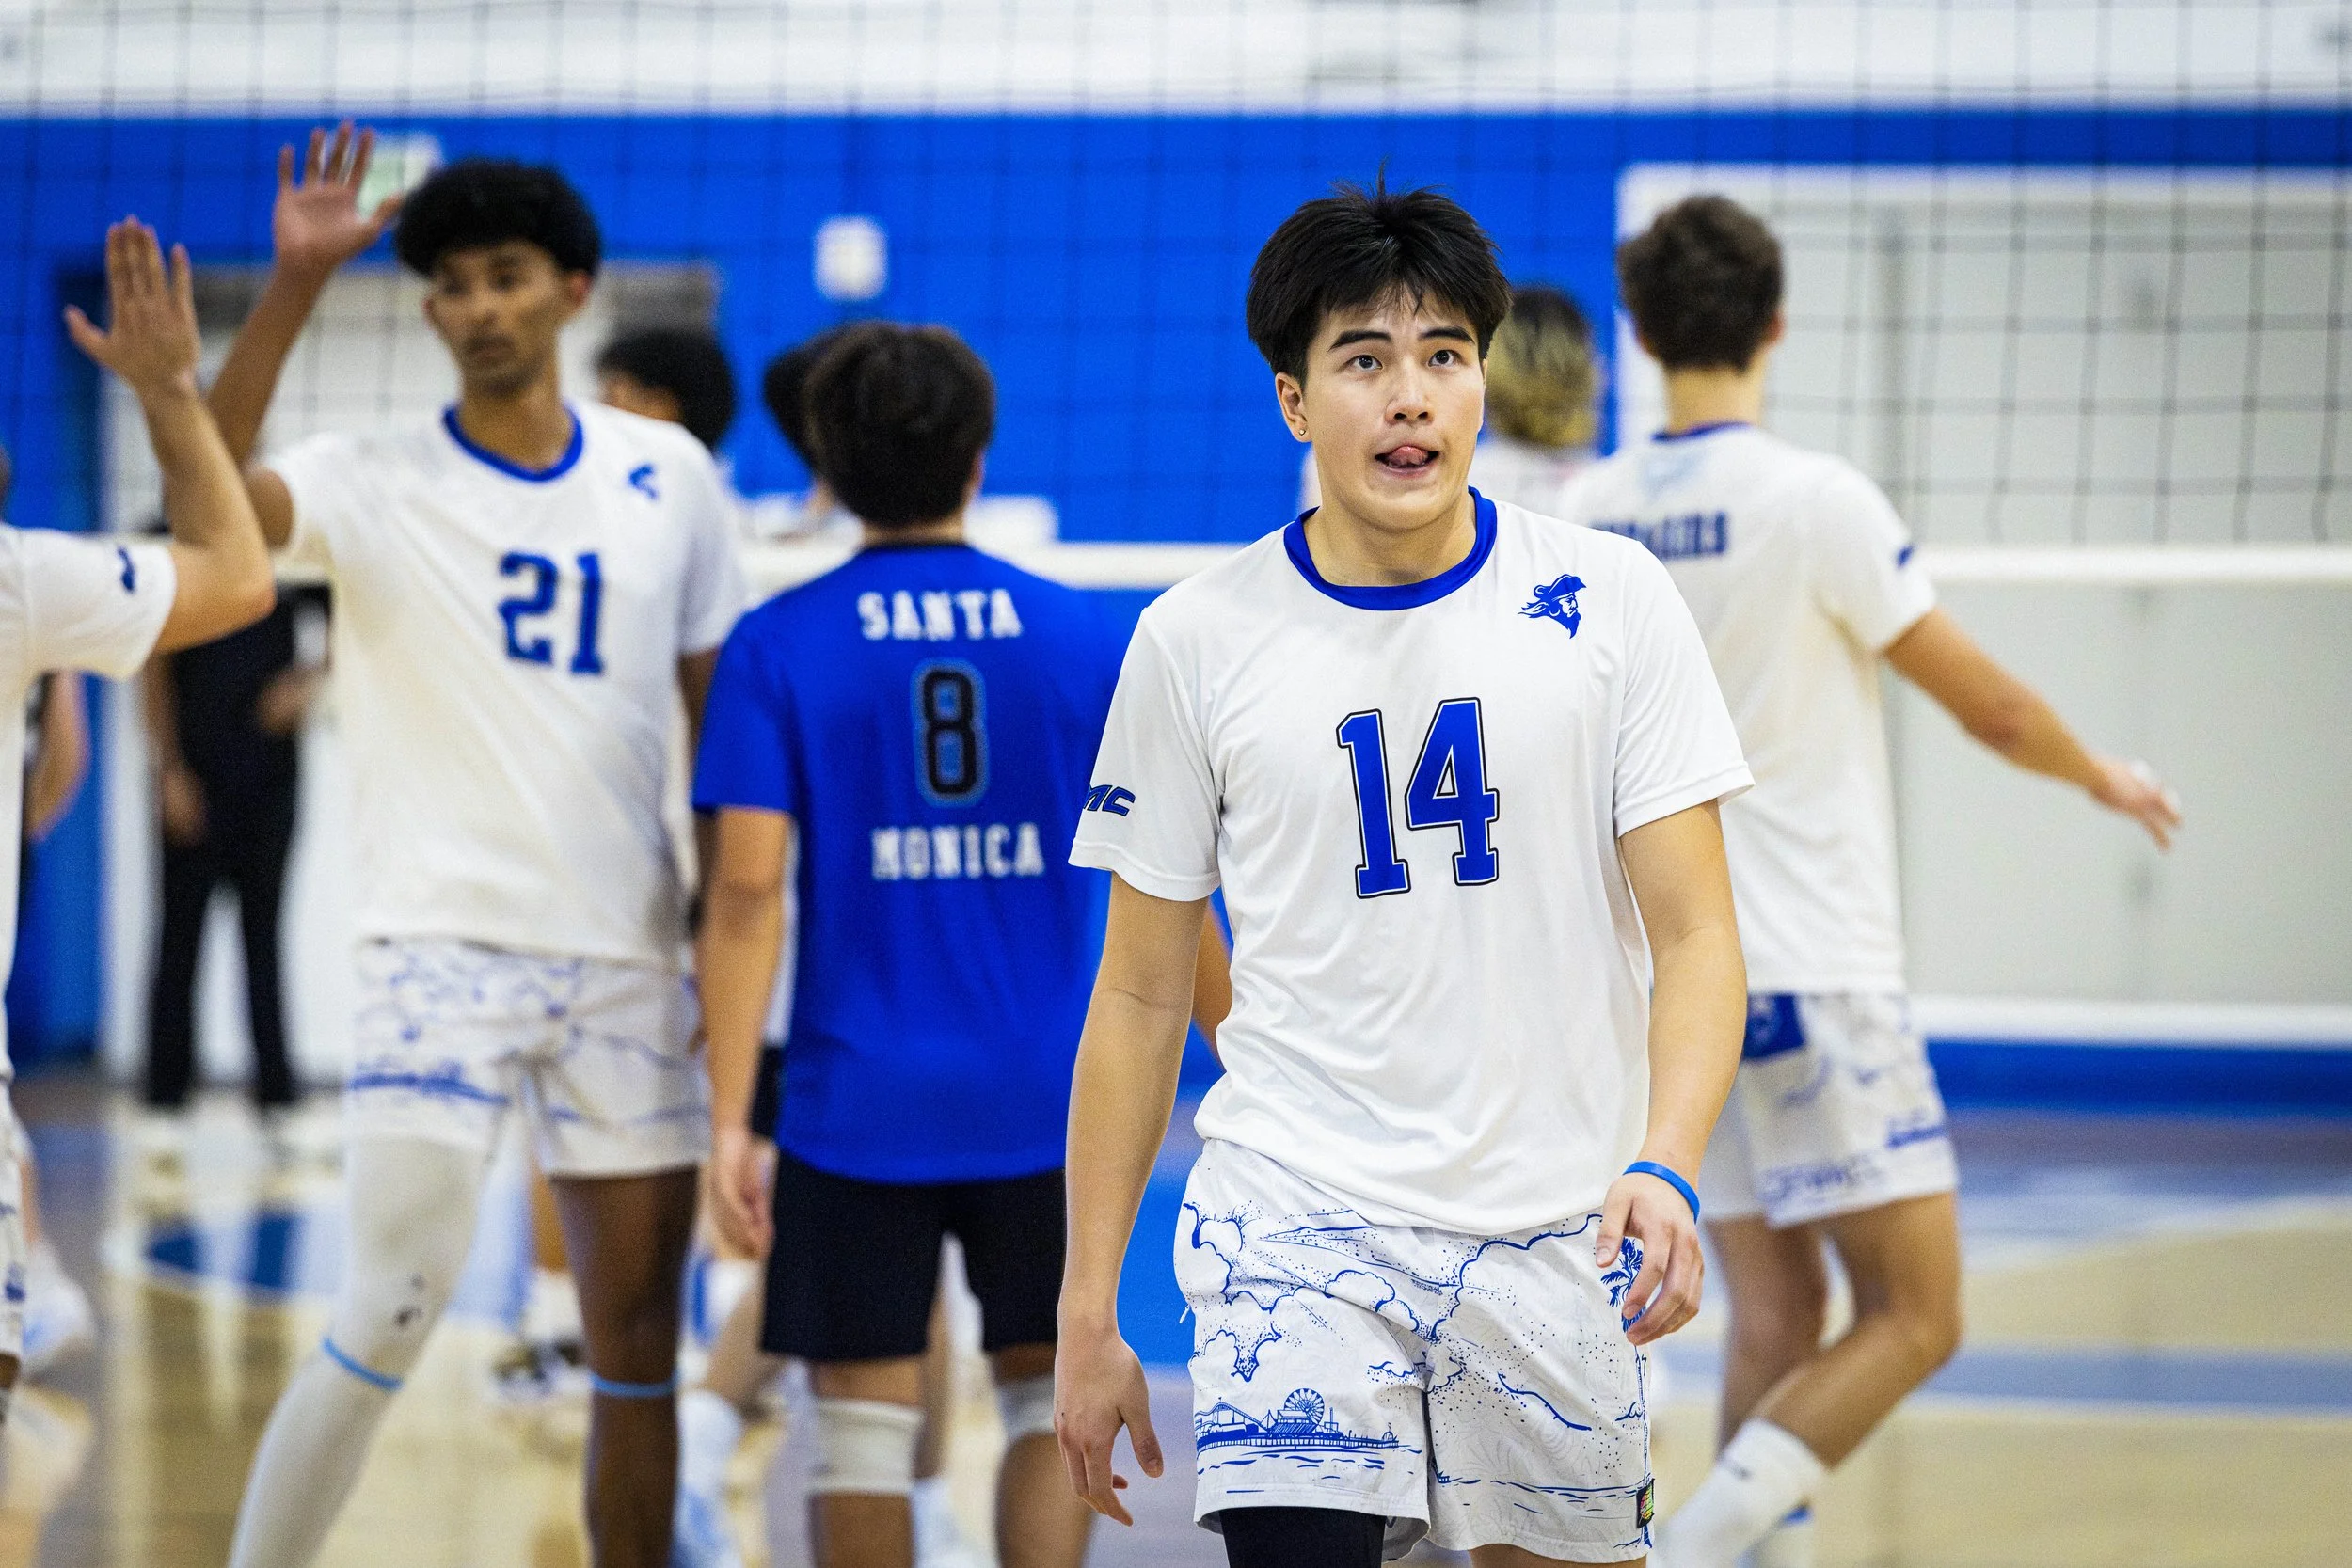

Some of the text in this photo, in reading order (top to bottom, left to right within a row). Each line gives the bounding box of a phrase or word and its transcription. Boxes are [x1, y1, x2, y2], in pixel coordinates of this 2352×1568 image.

[498, 549, 604, 675] 21
[857, 589, 1023, 641] SANTA
[914, 660, 987, 806] 8
[871, 821, 1044, 880] MONICA
[1336, 697, 1500, 899] 14
